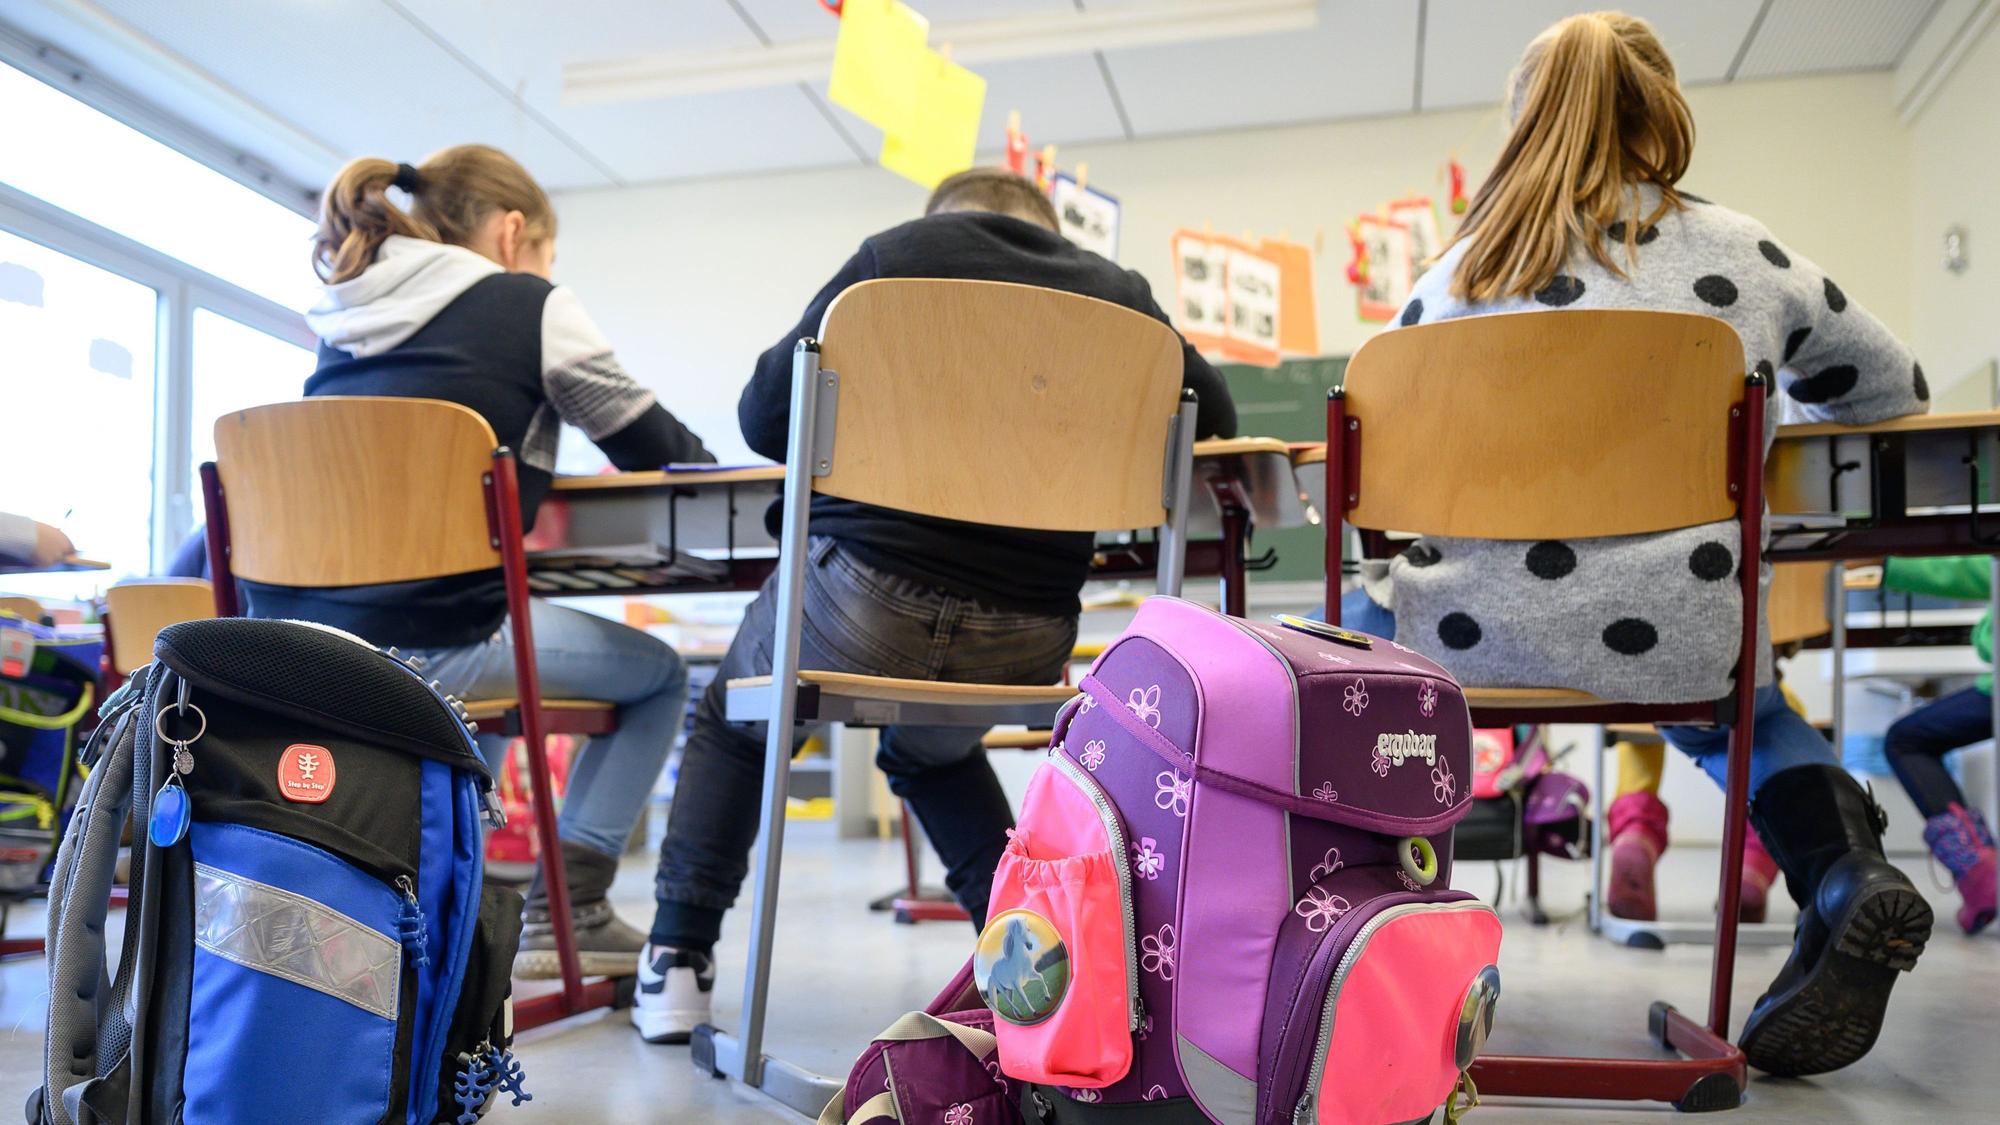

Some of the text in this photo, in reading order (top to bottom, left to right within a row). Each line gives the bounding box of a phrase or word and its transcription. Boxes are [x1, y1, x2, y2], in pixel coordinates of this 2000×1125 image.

[1378, 729, 1436, 766] ergobag
[288, 780, 301, 788] Step
[311, 782, 324, 790] Step
